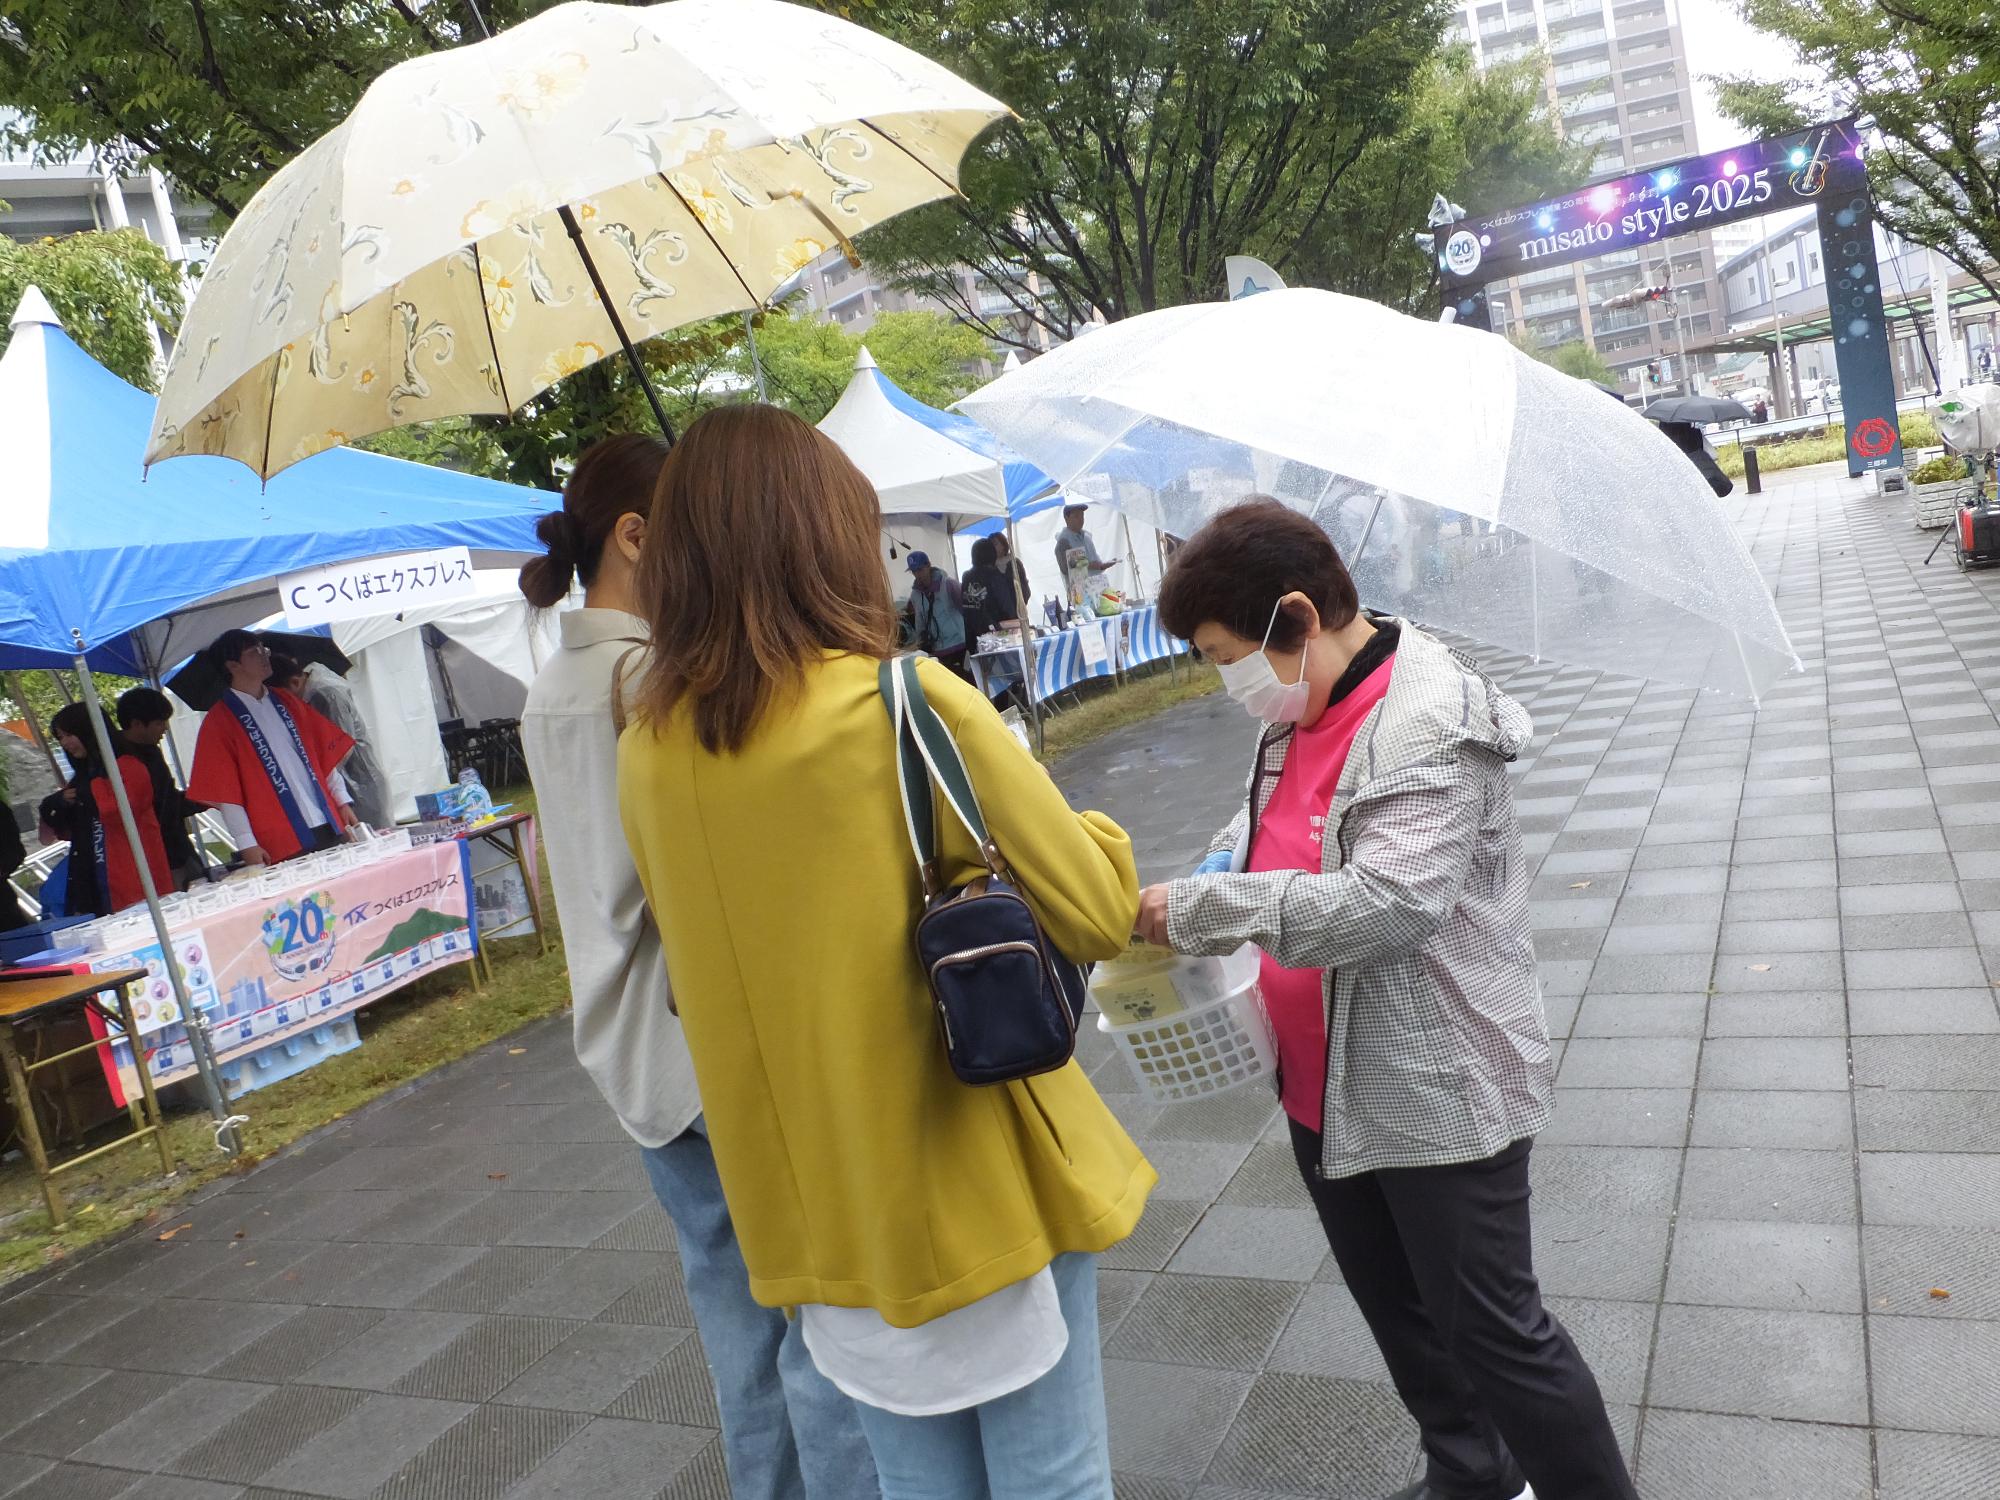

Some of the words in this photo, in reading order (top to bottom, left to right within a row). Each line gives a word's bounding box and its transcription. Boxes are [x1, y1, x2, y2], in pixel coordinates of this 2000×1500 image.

[1518, 222, 1614, 261] misato
[1621, 194, 1690, 238] style
[1691, 167, 1773, 218] 2025
[291, 586, 310, 610] C
[317, 559, 472, 604] つくばエクスプレス
[373, 874, 458, 915] つくばエクスプレス
